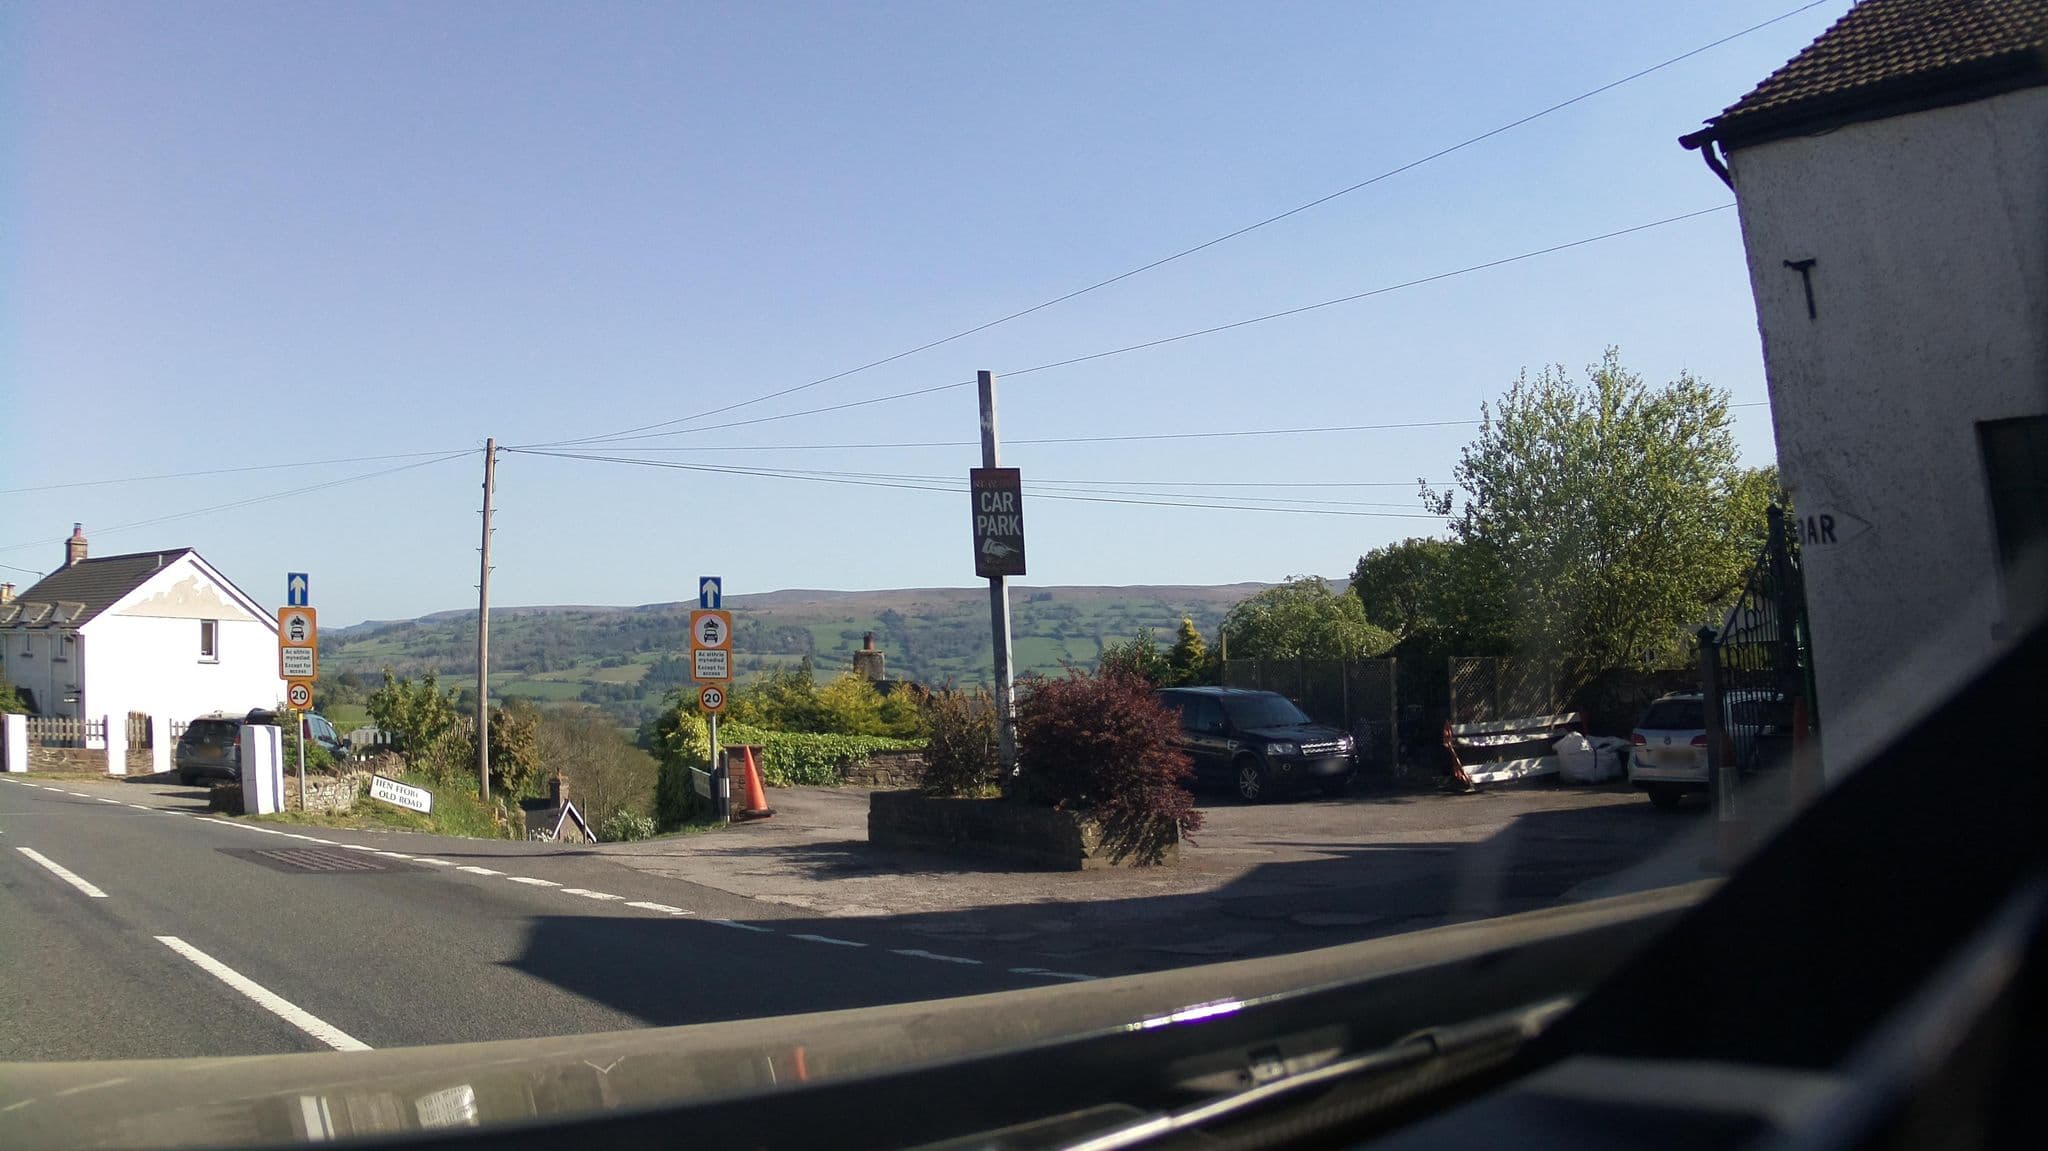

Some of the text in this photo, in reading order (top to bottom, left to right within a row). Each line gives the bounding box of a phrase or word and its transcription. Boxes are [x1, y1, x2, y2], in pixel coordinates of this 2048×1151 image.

[981, 491, 1014, 512] CAR
[977, 515, 1021, 536] PARK
[292, 690, 307, 701] 20
[704, 693, 720, 703] 20
[376, 778, 393, 790] HEN
[379, 790, 423, 808] OLD ROAD
